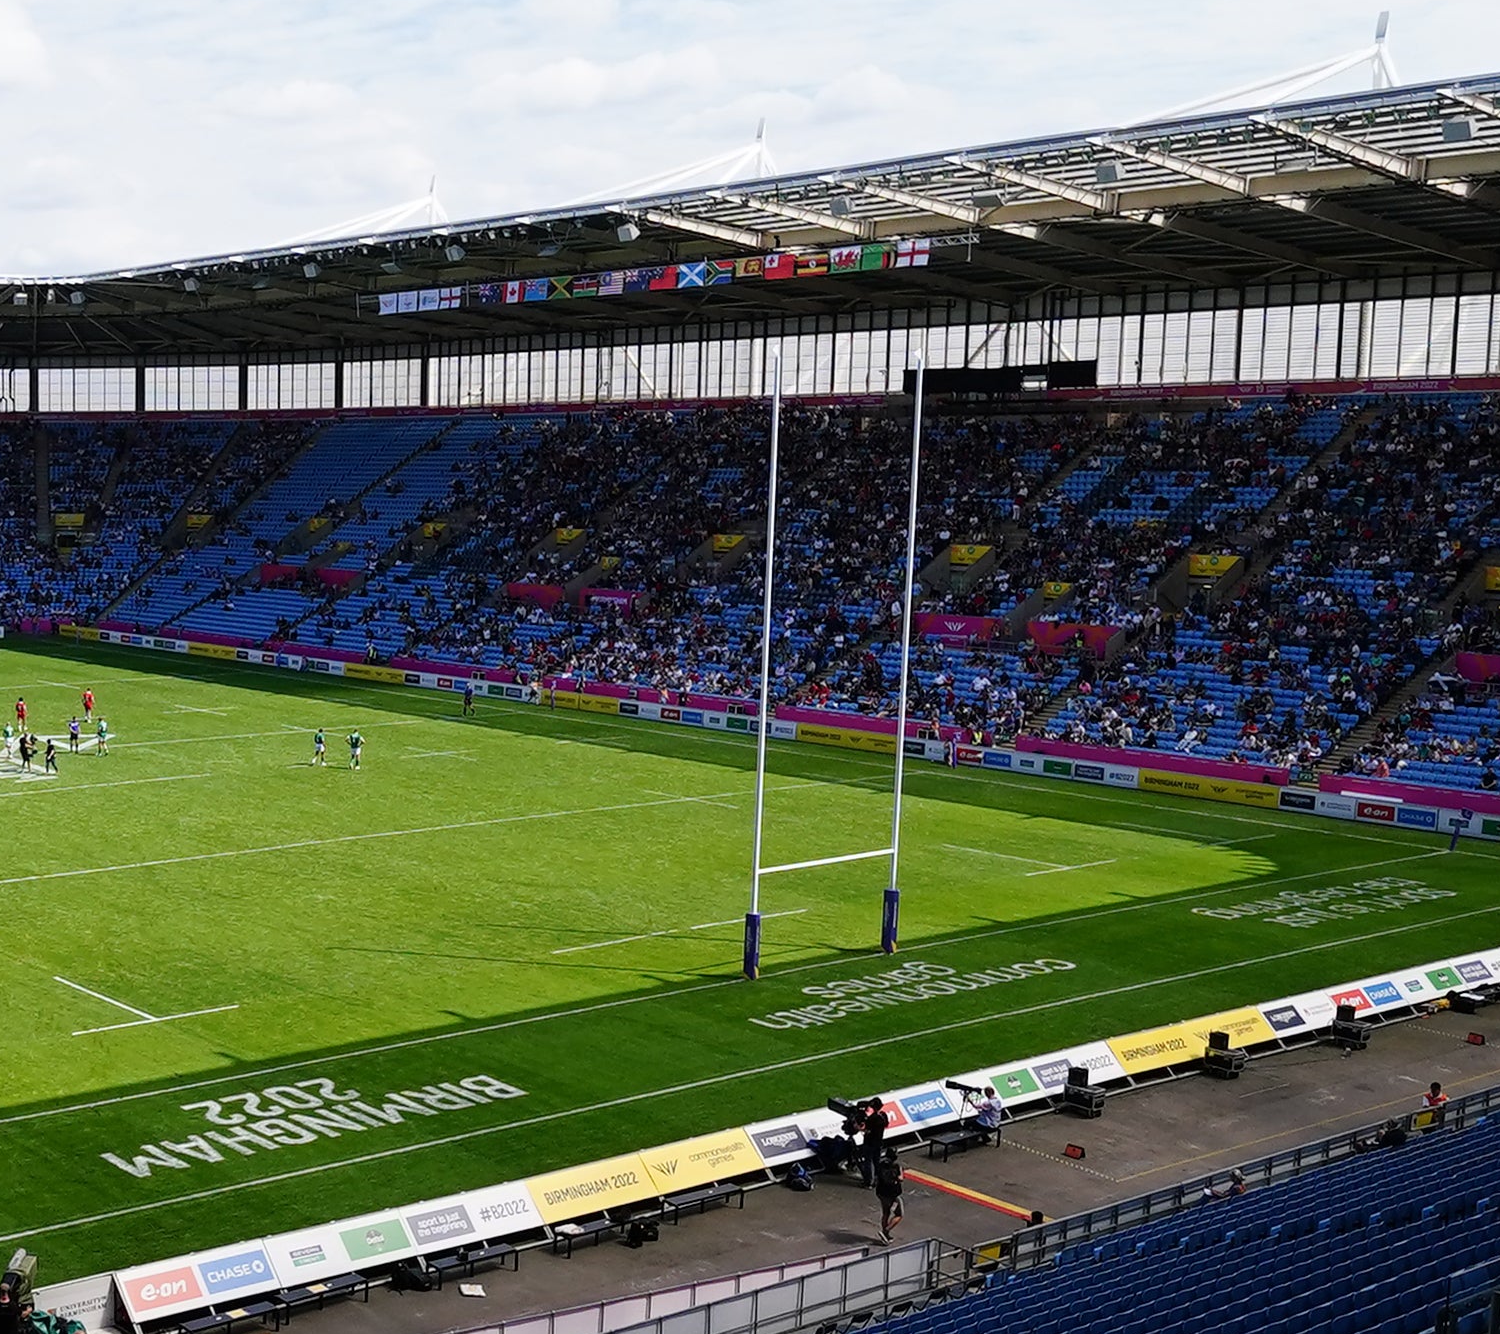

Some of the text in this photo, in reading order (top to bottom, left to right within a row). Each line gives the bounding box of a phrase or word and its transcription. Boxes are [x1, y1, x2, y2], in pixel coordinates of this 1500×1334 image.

[1144, 776, 1200, 791] BIRMINGHAM 2022
[801, 961, 956, 999] games
[748, 958, 1076, 1030] commonwealth
[1121, 1037, 1188, 1062] BIRMINGHAM 2022
[180, 1077, 361, 1127] 2022
[907, 1099, 936, 1114] CHASE
[100, 1074, 529, 1178] BIRMINGHAM
[688, 1140, 746, 1163] commonwealth
[708, 1153, 735, 1168] games
[543, 1171, 640, 1206] BIRMINGHAM 2022
[418, 1217, 438, 1229] sport
[446, 1212, 460, 1226] just
[479, 1198, 530, 1223] #B2022
[418, 1220, 468, 1238] the beginning
[206, 1262, 253, 1285] CHASE
[59, 1298, 96, 1312] UNIVERSITY
